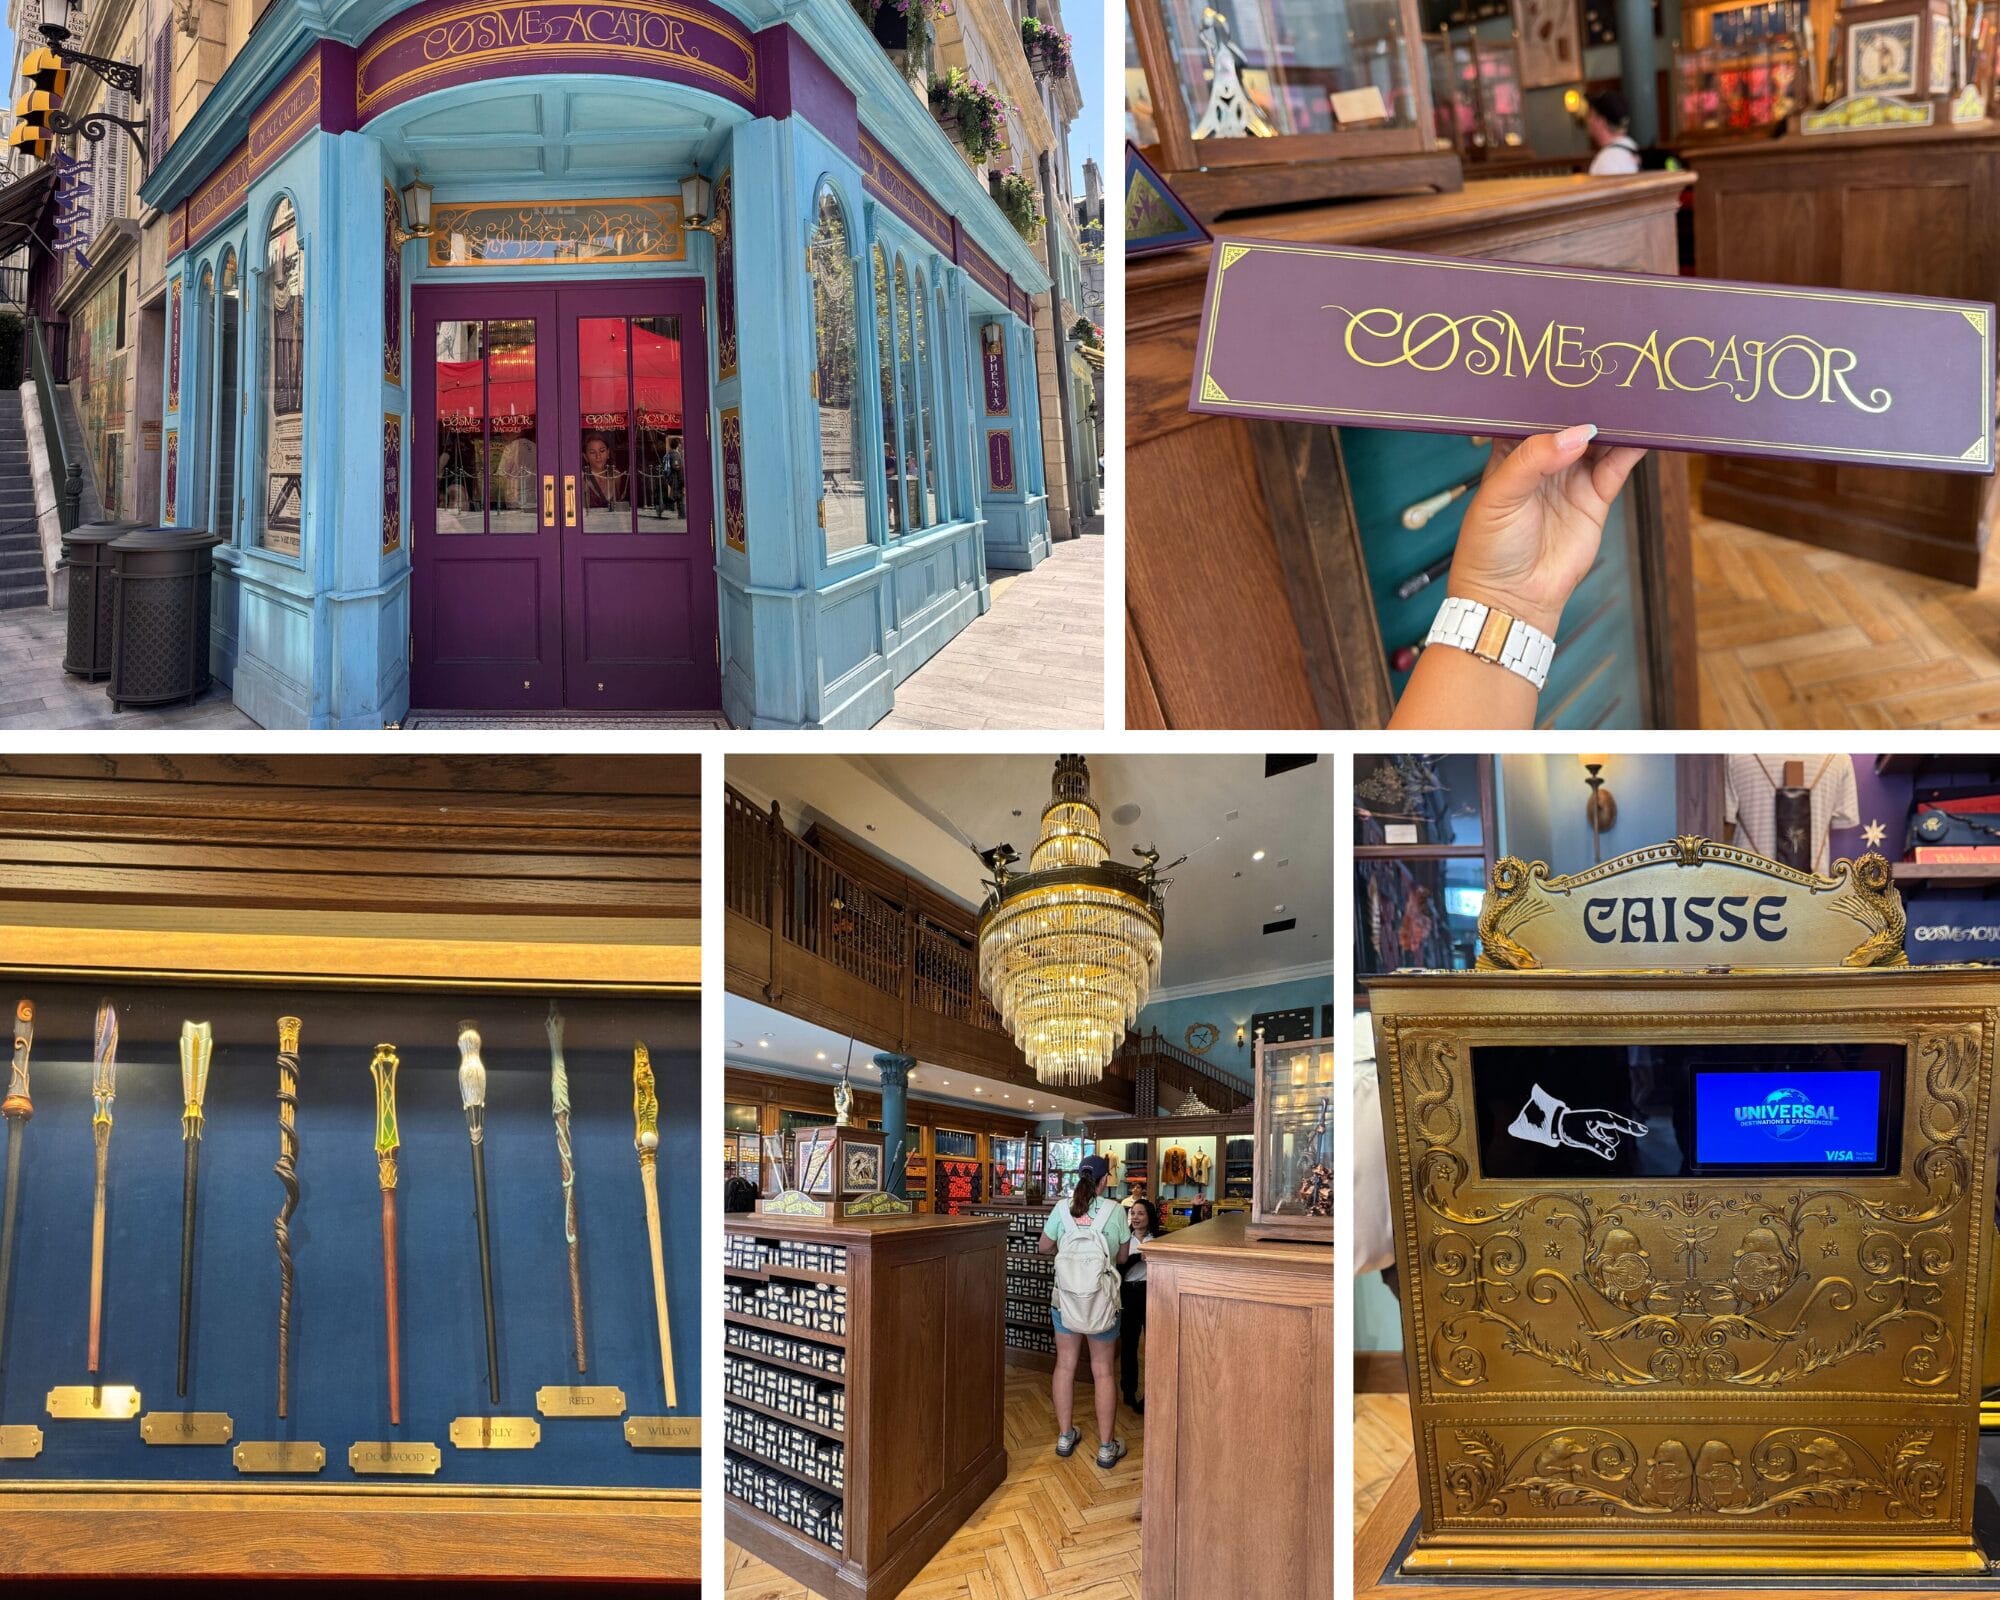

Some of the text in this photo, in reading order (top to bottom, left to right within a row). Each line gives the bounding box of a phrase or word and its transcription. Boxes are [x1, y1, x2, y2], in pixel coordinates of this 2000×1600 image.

[417, 7, 700, 61] COSME ACAJOR
[1321, 304, 1892, 414] COSME ACAJOR
[1583, 895, 1788, 944] CAISSE
[1734, 1104, 1839, 1121] UNIVERSAL
[1740, 1118, 1784, 1127] DESTINATIONS
[1792, 1118, 1833, 1126] EXPERIENCES
[1824, 1150, 1853, 1161] VISA
[569, 1396, 595, 1405] REED
[175, 1423, 200, 1432] OAK
[478, 1428, 513, 1437] HOLLY
[647, 1426, 692, 1436] WILLOW
